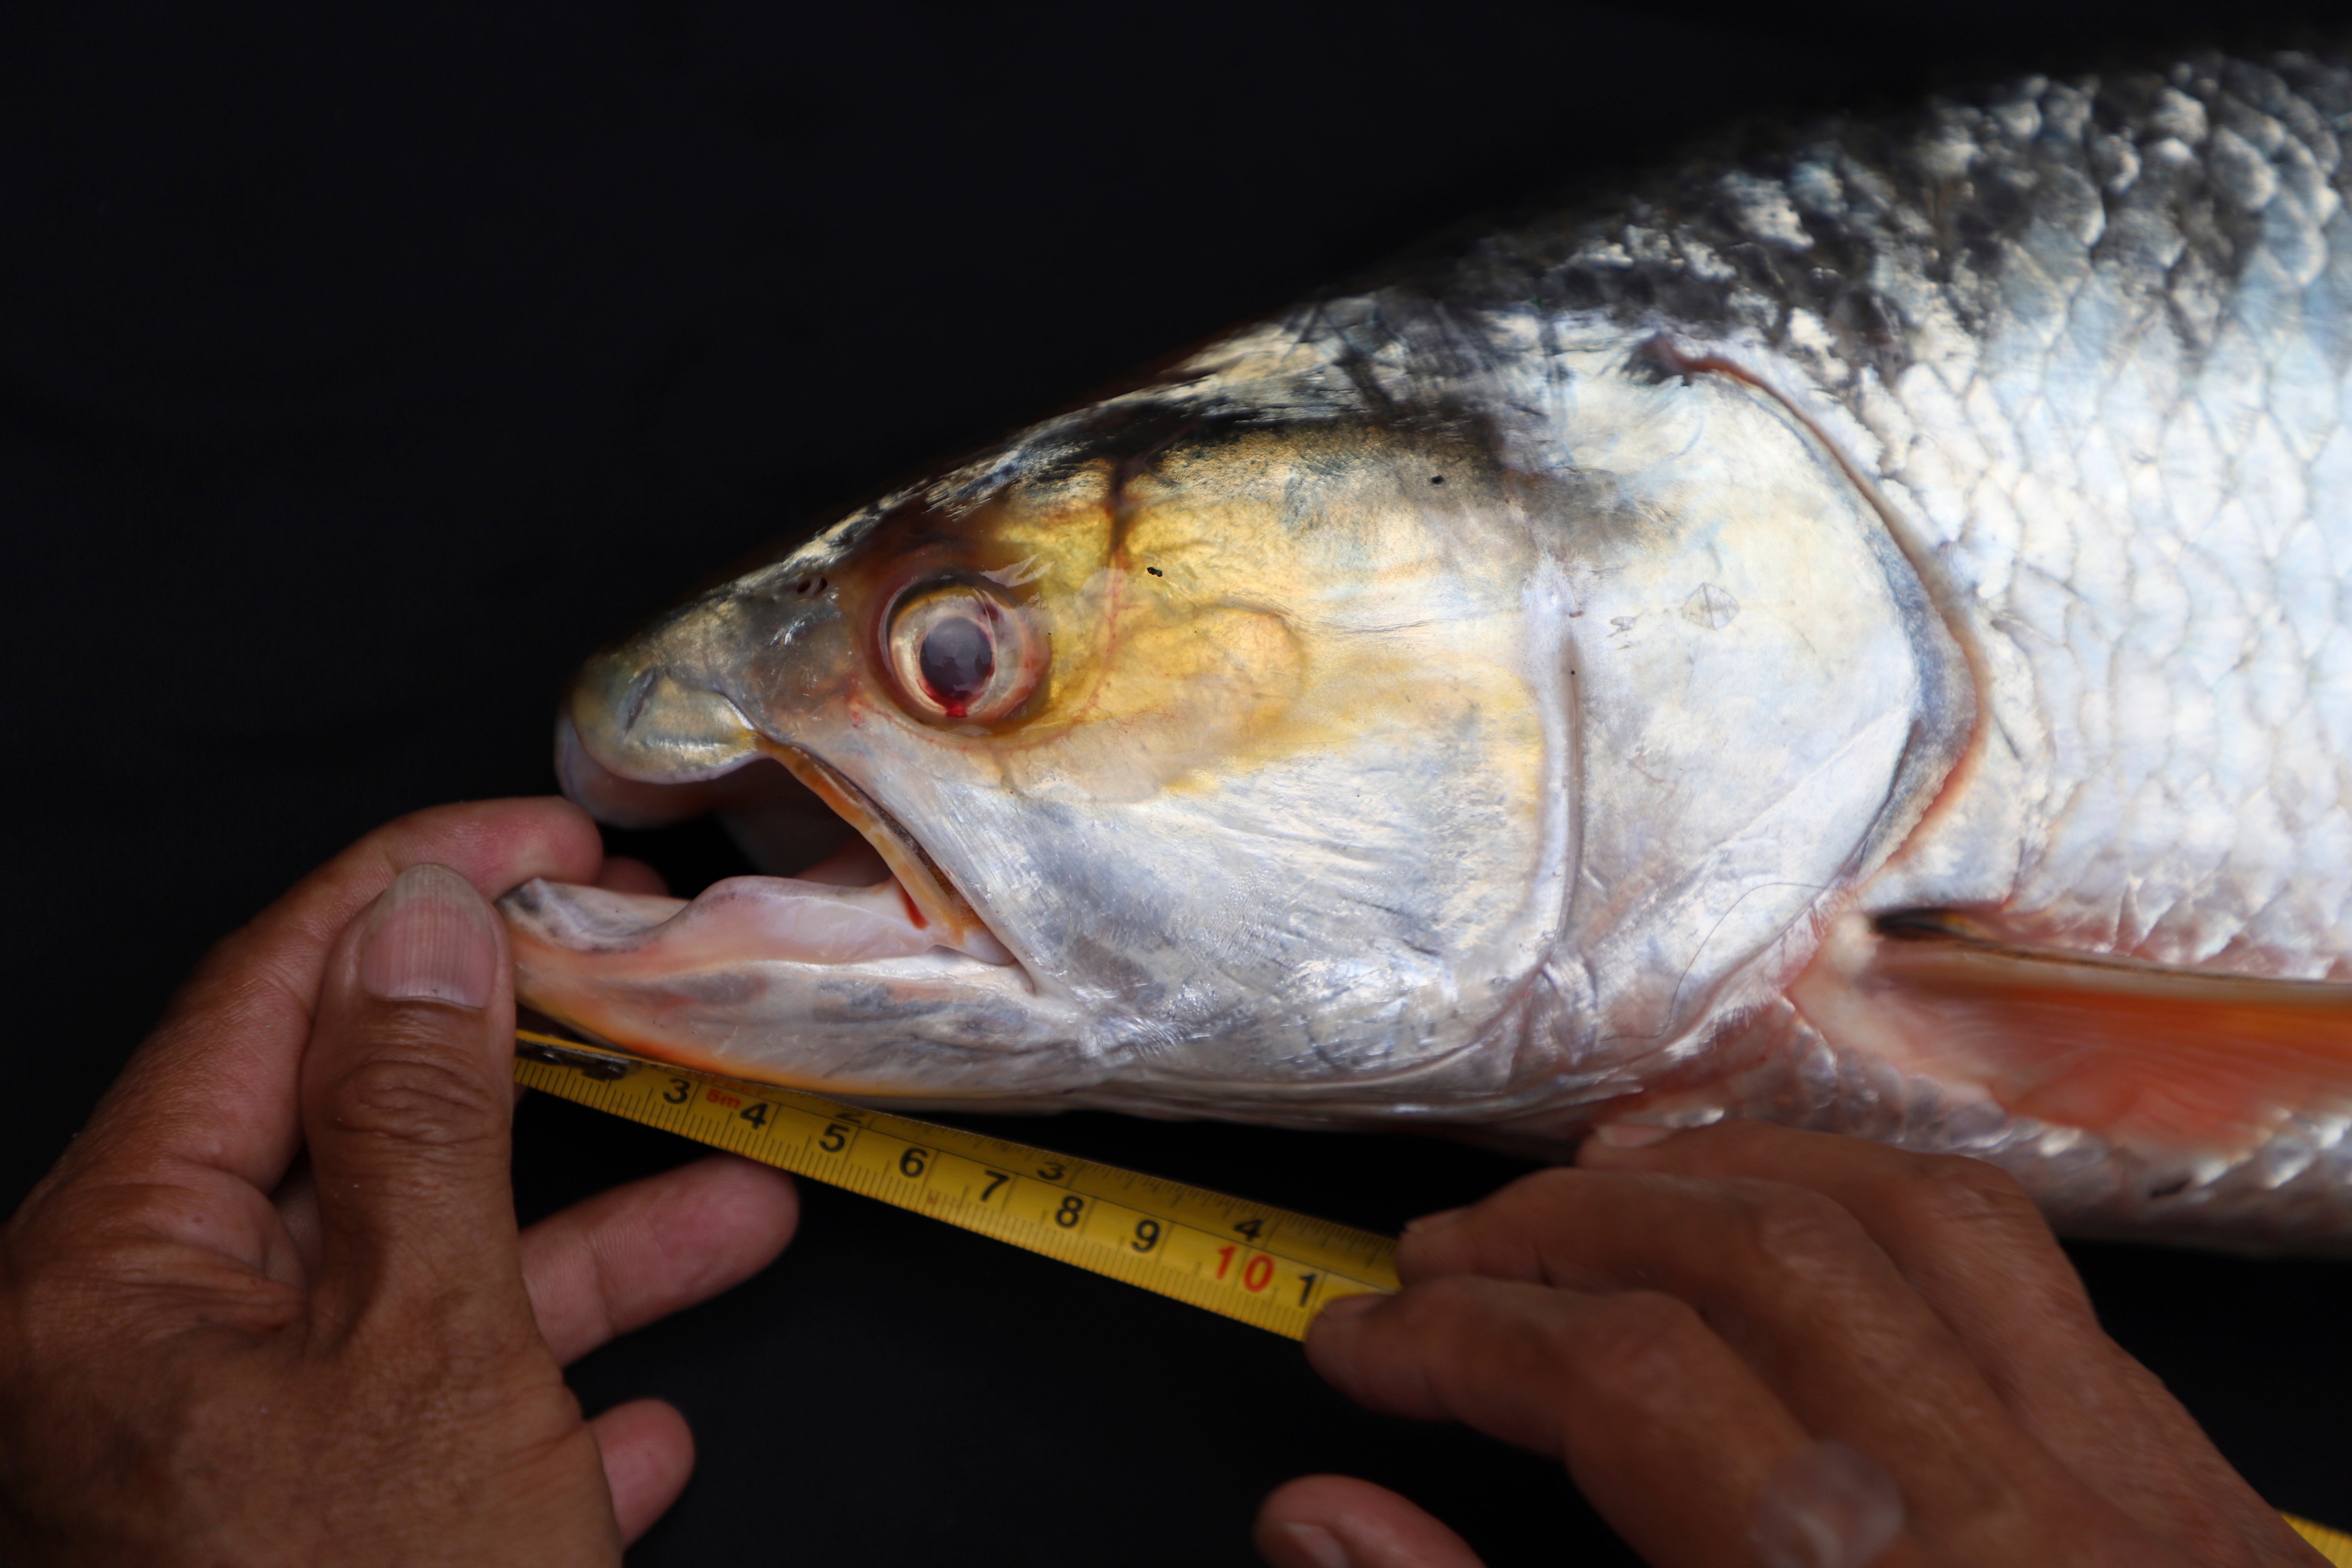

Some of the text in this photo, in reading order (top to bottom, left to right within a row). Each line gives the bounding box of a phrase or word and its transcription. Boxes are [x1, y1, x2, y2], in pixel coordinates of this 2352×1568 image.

[663, 1078, 690, 1104] 3
[706, 1089, 741, 1109] 5m
[740, 1103, 769, 1130] 4
[834, 1108, 866, 1124] 2
[819, 1124, 850, 1153] 5
[899, 1148, 928, 1178] 6
[1037, 1162, 1066, 1181] 3
[980, 1170, 1009, 1202] 7
[1054, 1196, 1084, 1228] 8
[1131, 1219, 1160, 1253] 9
[1233, 1219, 1265, 1242] 4
[1216, 1245, 1274, 1293] 10
